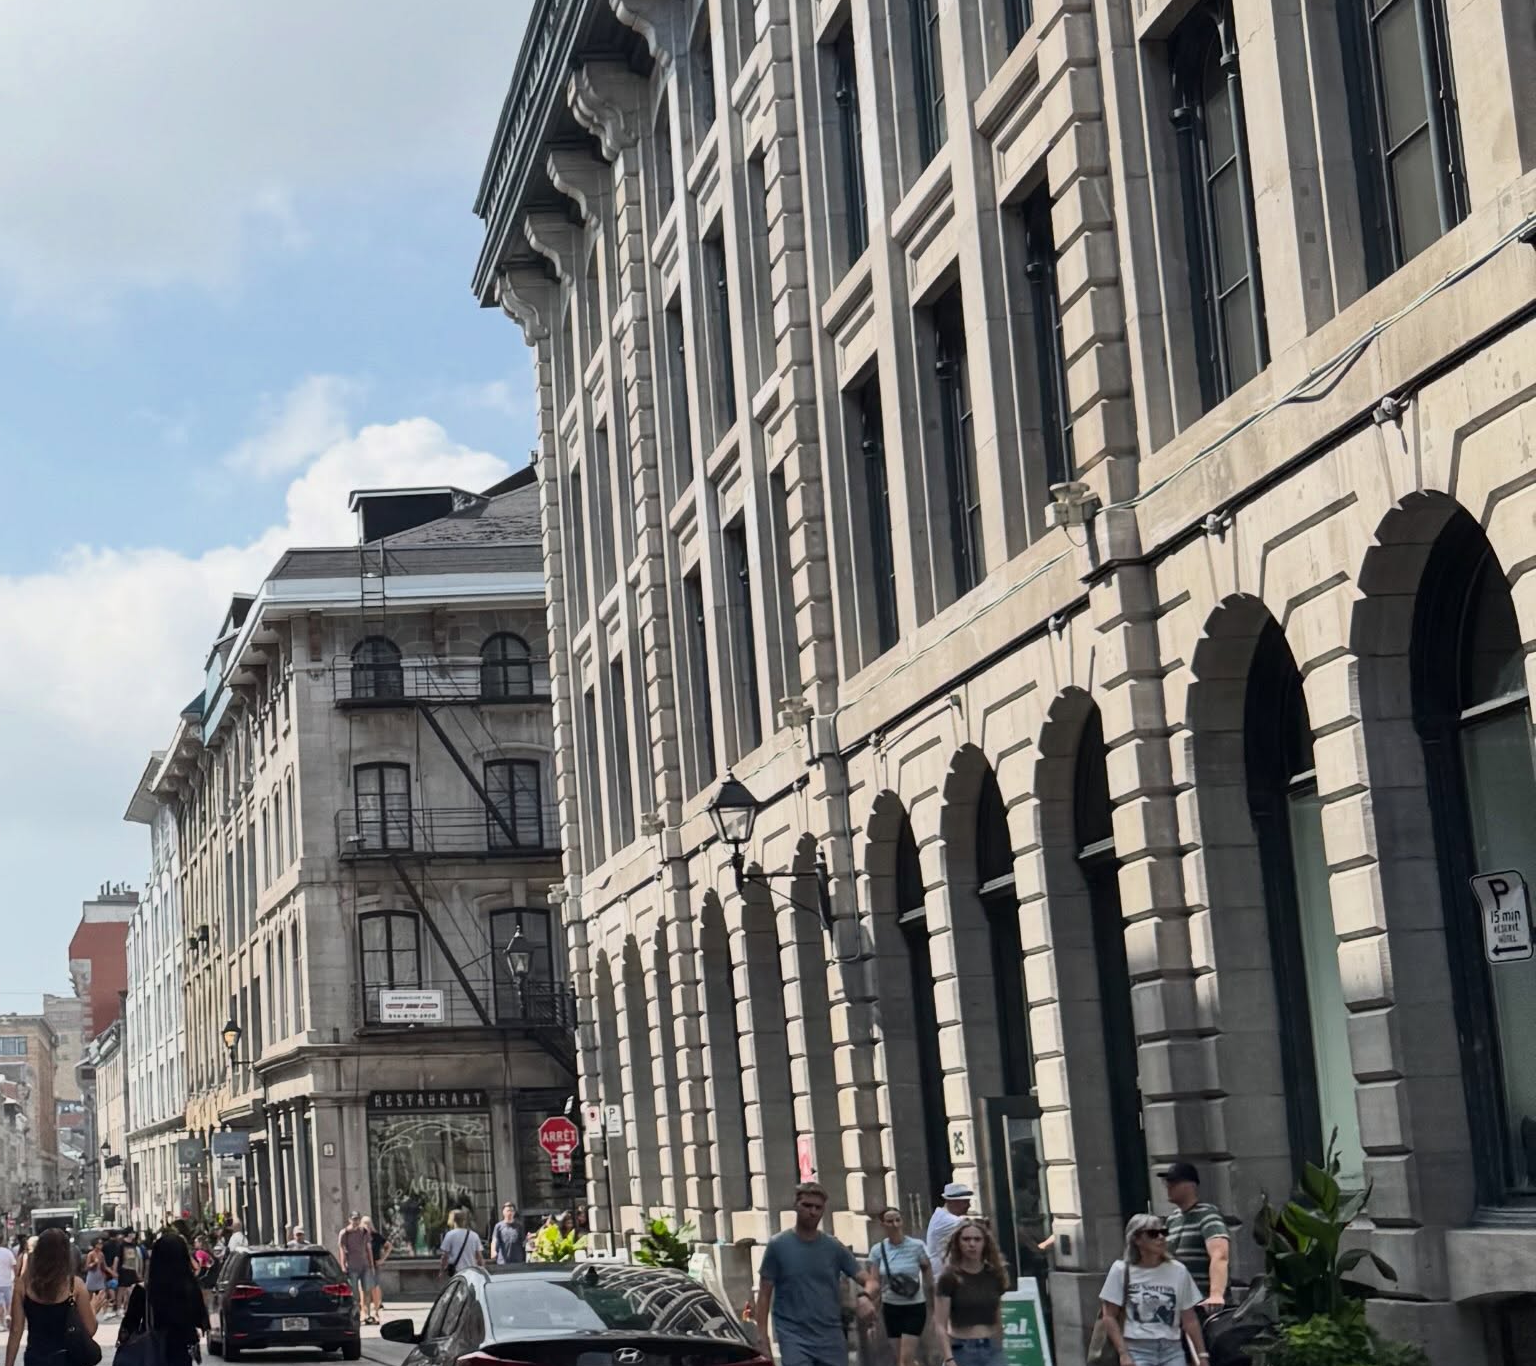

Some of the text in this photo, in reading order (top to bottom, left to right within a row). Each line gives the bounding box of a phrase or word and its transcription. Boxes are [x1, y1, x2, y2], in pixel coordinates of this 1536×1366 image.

[1487, 878, 1509, 910] P
[1490, 910, 1520, 923] 15 min
[374, 1093, 481, 1108] RESTAURANT
[542, 1128, 576, 1143] ARRÊT
